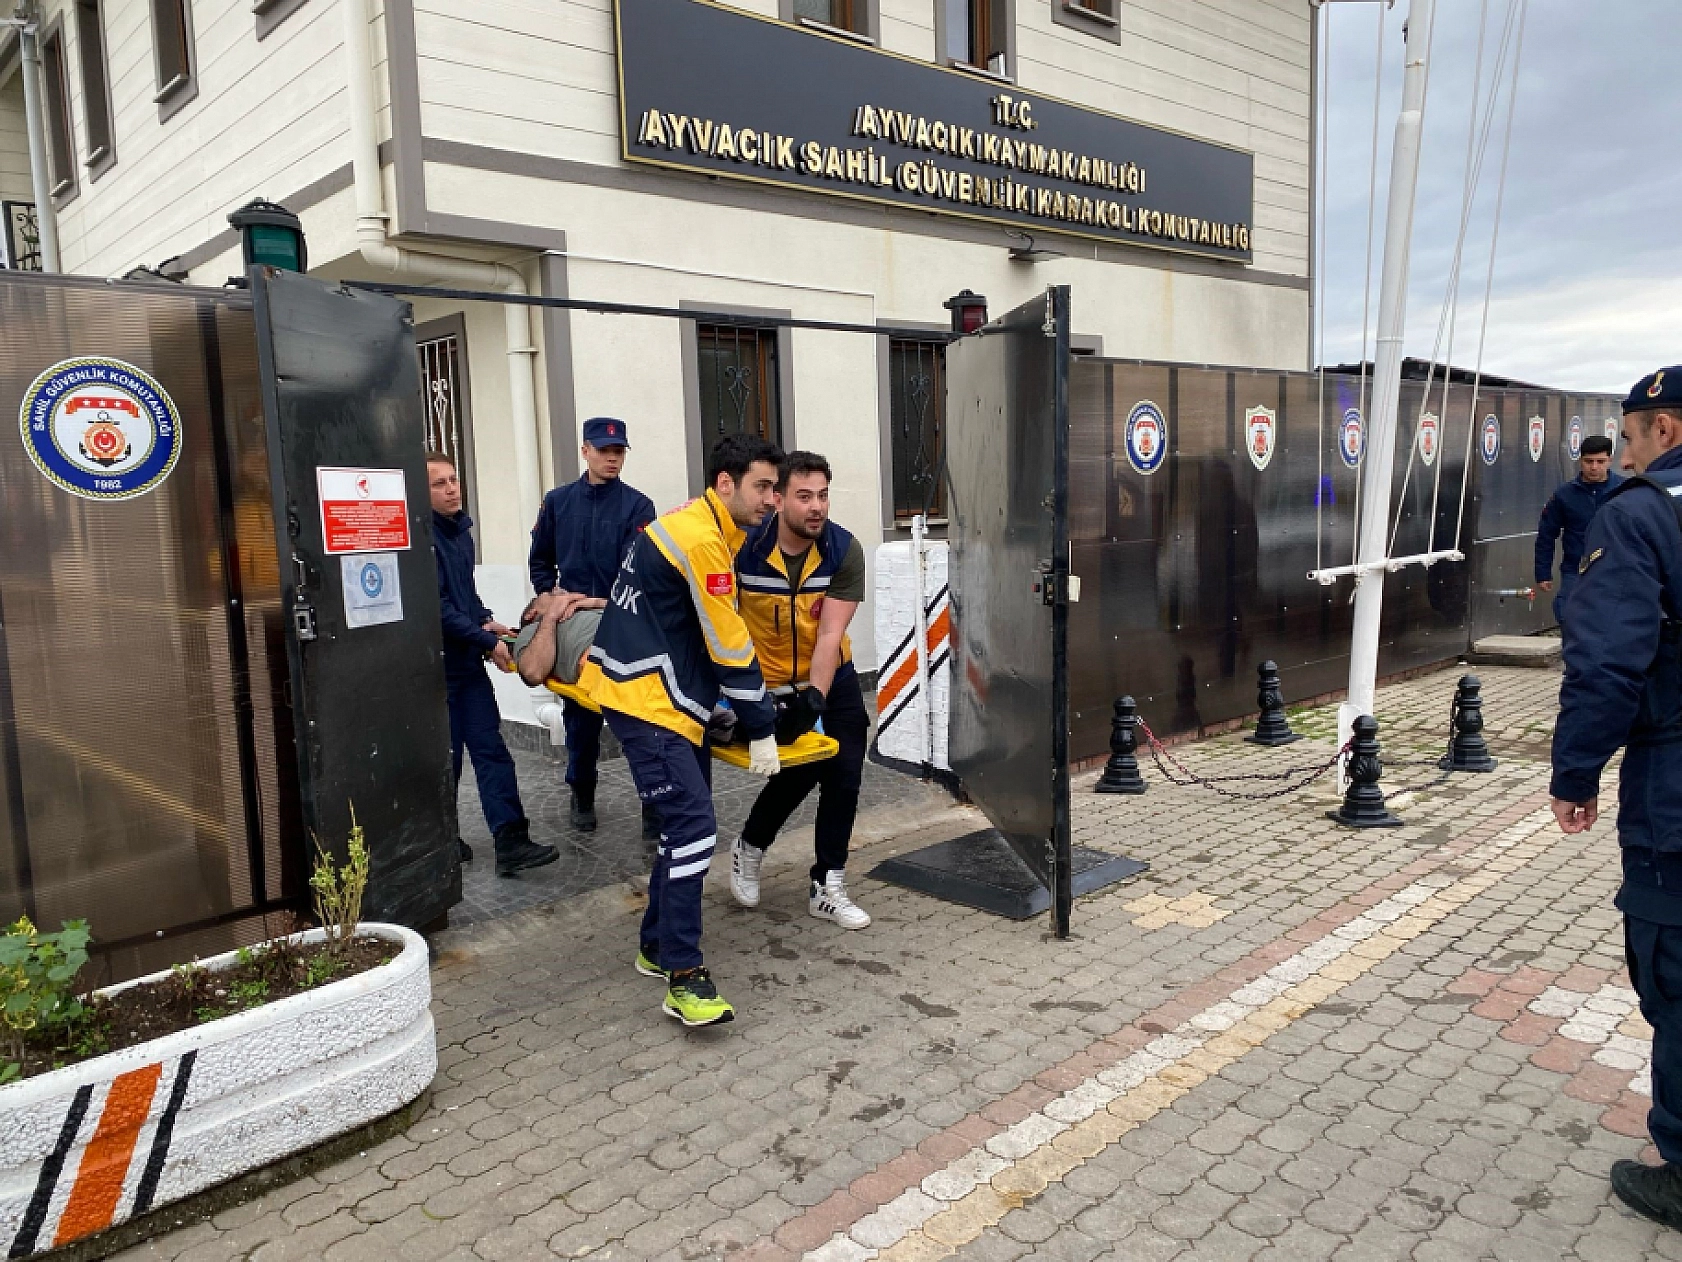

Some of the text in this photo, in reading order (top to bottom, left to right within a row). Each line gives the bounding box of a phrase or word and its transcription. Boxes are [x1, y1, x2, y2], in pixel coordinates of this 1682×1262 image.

[853, 104, 975, 159] AYVACIK
[994, 94, 1038, 129] T.C.
[638, 108, 795, 169] AYVACIK
[800, 141, 893, 187] SAHİL
[895, 158, 1029, 212] GÜVENLİK
[1031, 187, 1132, 230] KARAKOL
[46, 367, 107, 396] GÜVENLİK
